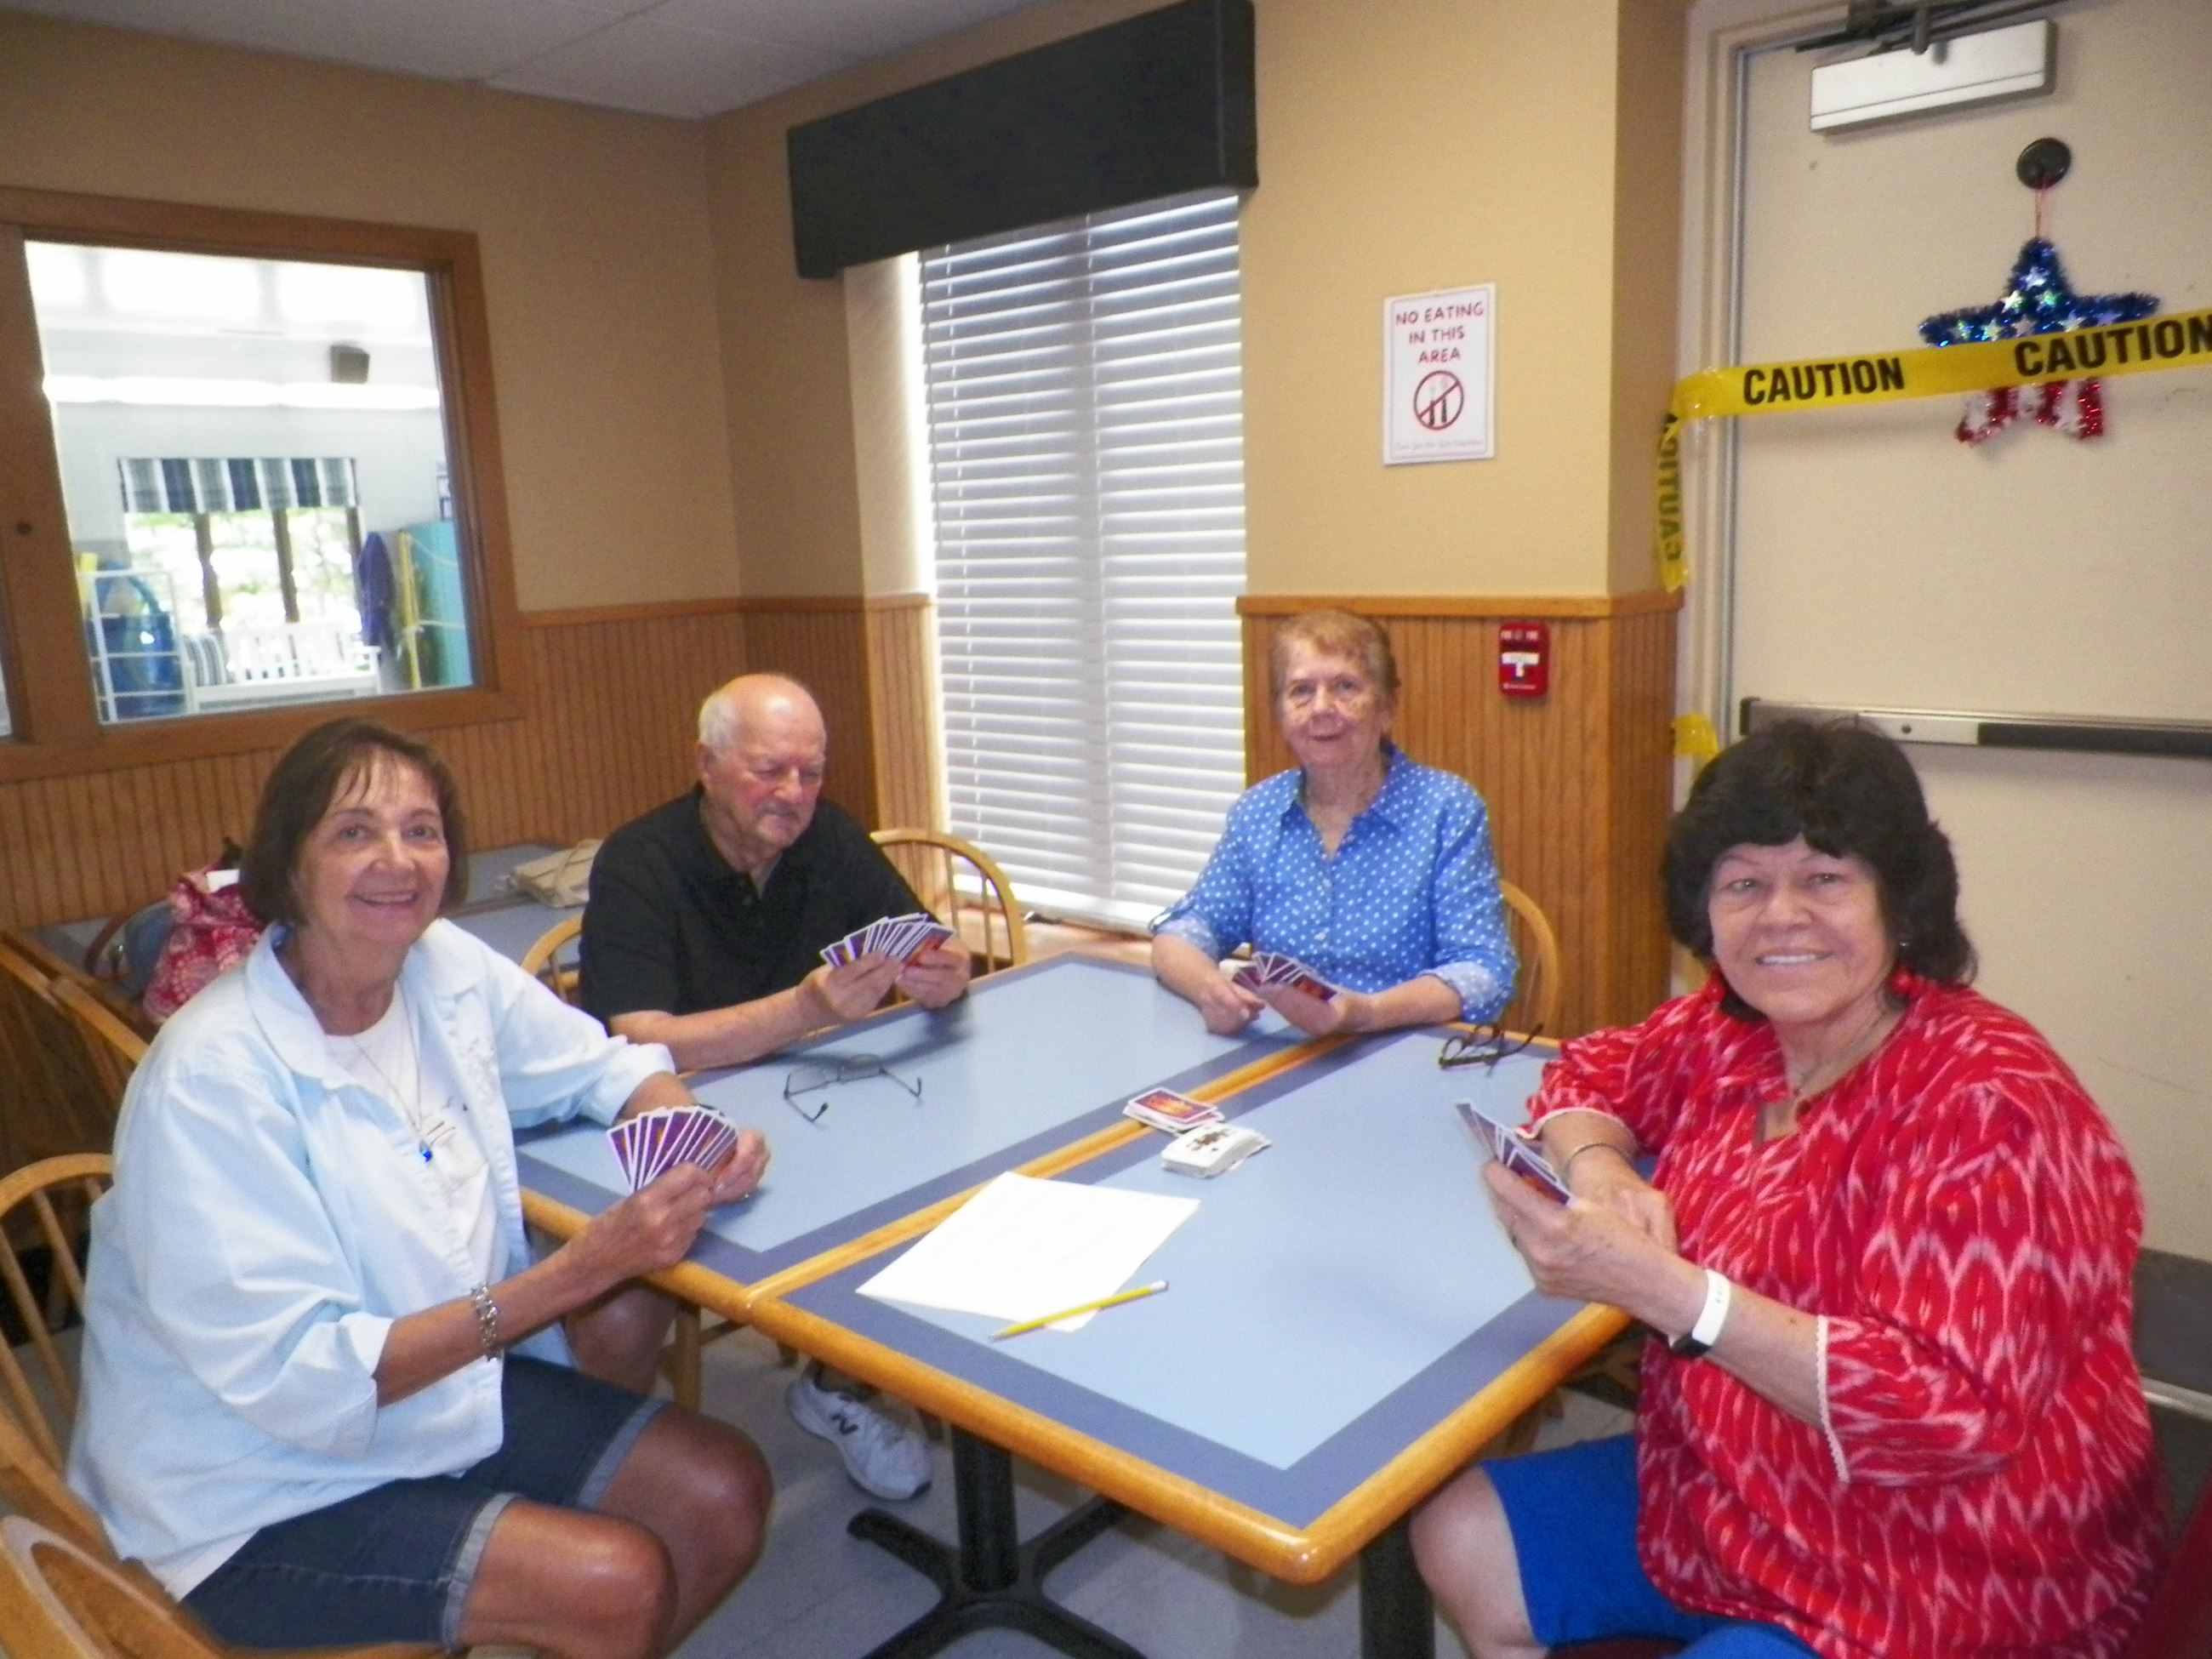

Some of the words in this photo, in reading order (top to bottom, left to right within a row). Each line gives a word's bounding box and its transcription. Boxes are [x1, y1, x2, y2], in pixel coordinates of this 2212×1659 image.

[1396, 311, 1418, 325] NO
[1425, 302, 1484, 322] EATING
[1409, 330, 1425, 343] IN
[1432, 326, 1465, 341] THIS
[1418, 347, 1461, 363] AREA
[1743, 357, 1905, 405] CAUTION
[2015, 314, 2212, 376] CAUTION
